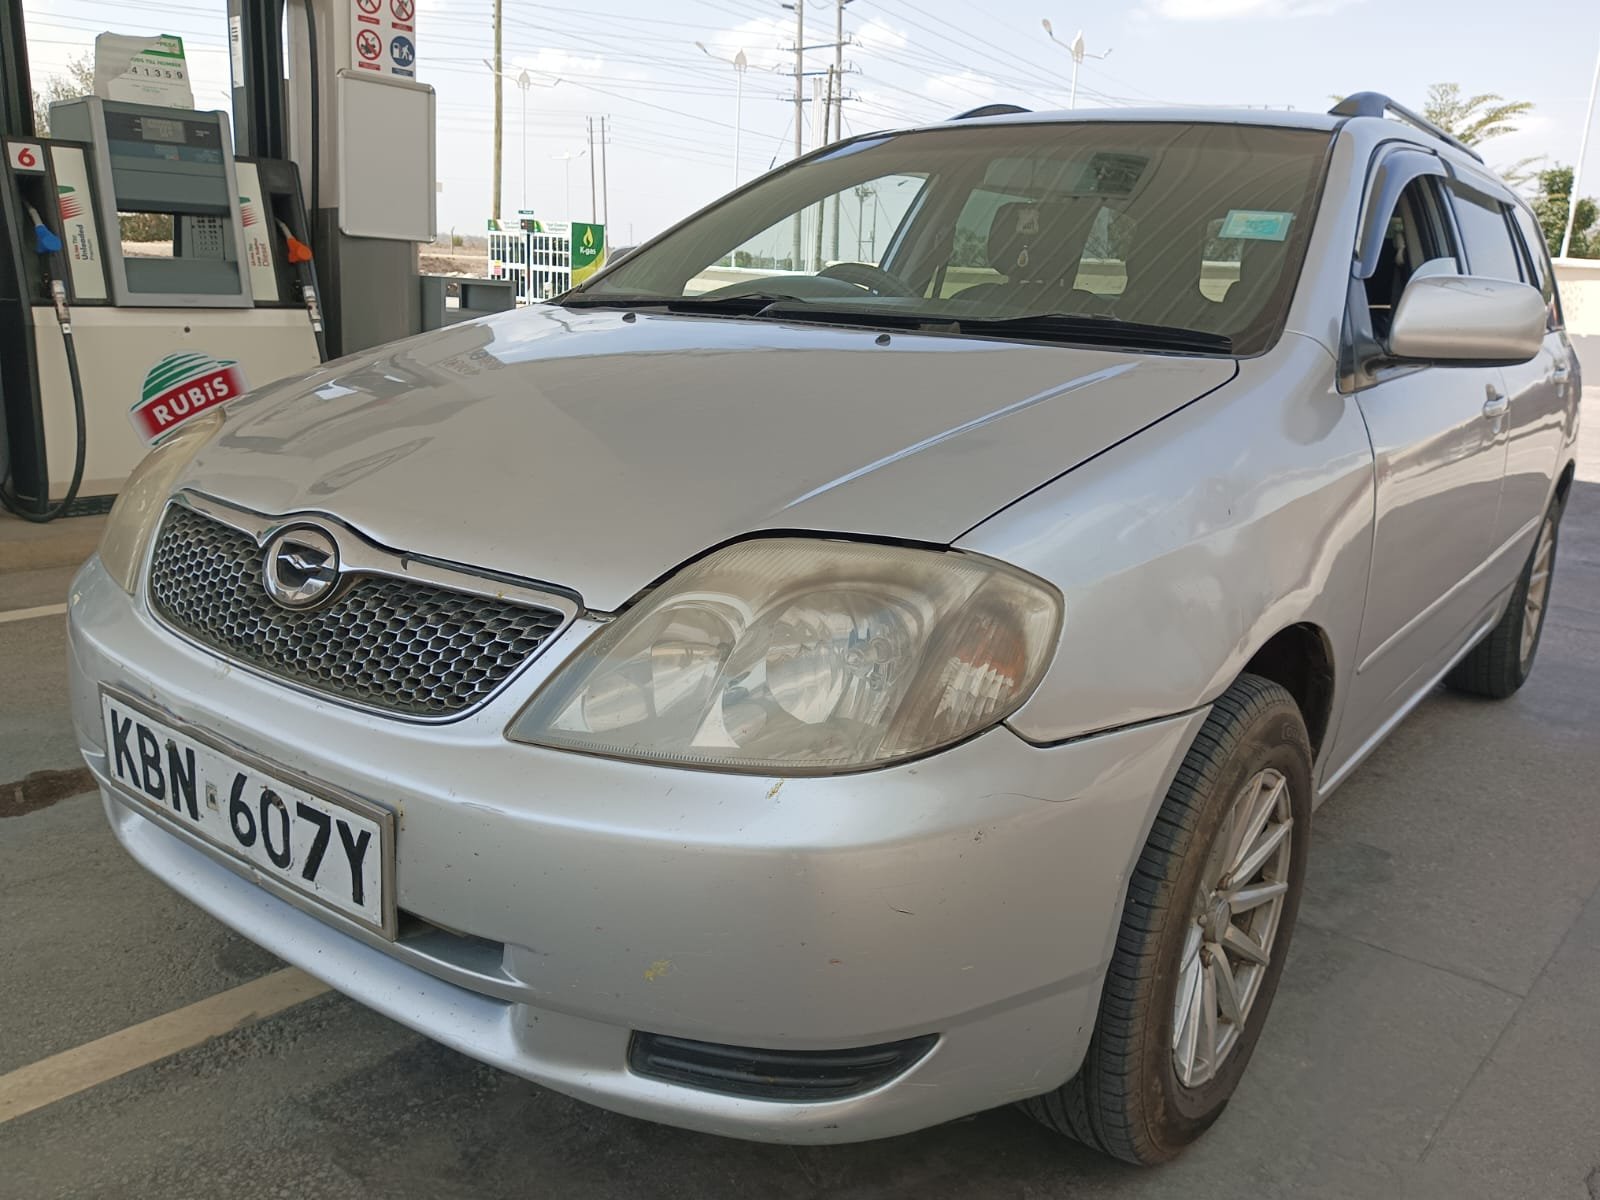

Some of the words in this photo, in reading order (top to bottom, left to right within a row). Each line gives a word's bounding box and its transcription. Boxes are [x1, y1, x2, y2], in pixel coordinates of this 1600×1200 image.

[18, 148, 36, 167] 6
[76, 224, 88, 260] Unleaded
[110, 708, 199, 821] KBN
[229, 772, 372, 906] 607Y
